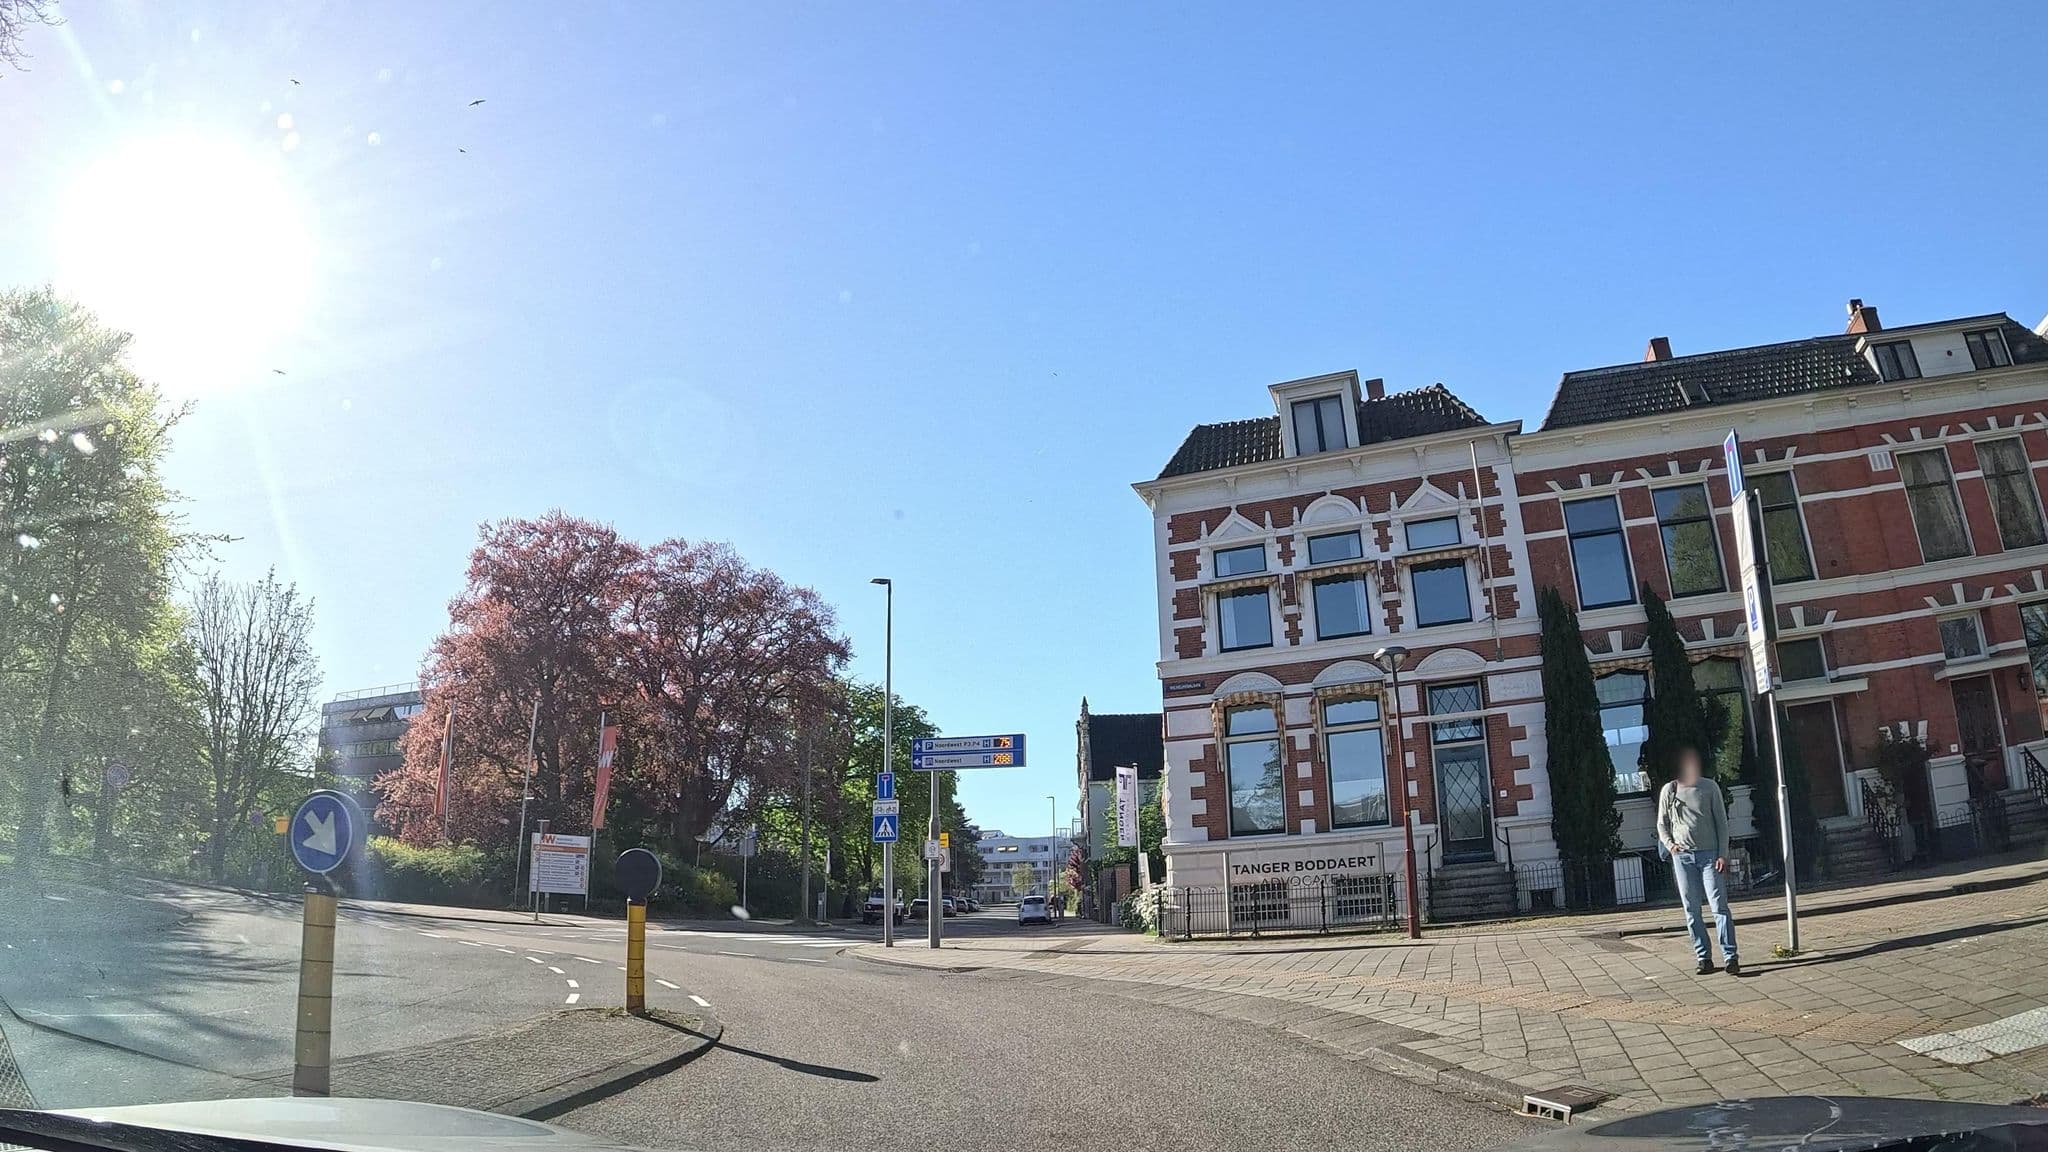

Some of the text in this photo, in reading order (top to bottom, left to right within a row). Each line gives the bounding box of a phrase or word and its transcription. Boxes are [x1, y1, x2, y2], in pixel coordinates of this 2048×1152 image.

[1232, 855, 1376, 875] TANGER BODDAERT
[1261, 873, 1350, 888] ADVOCATEN
